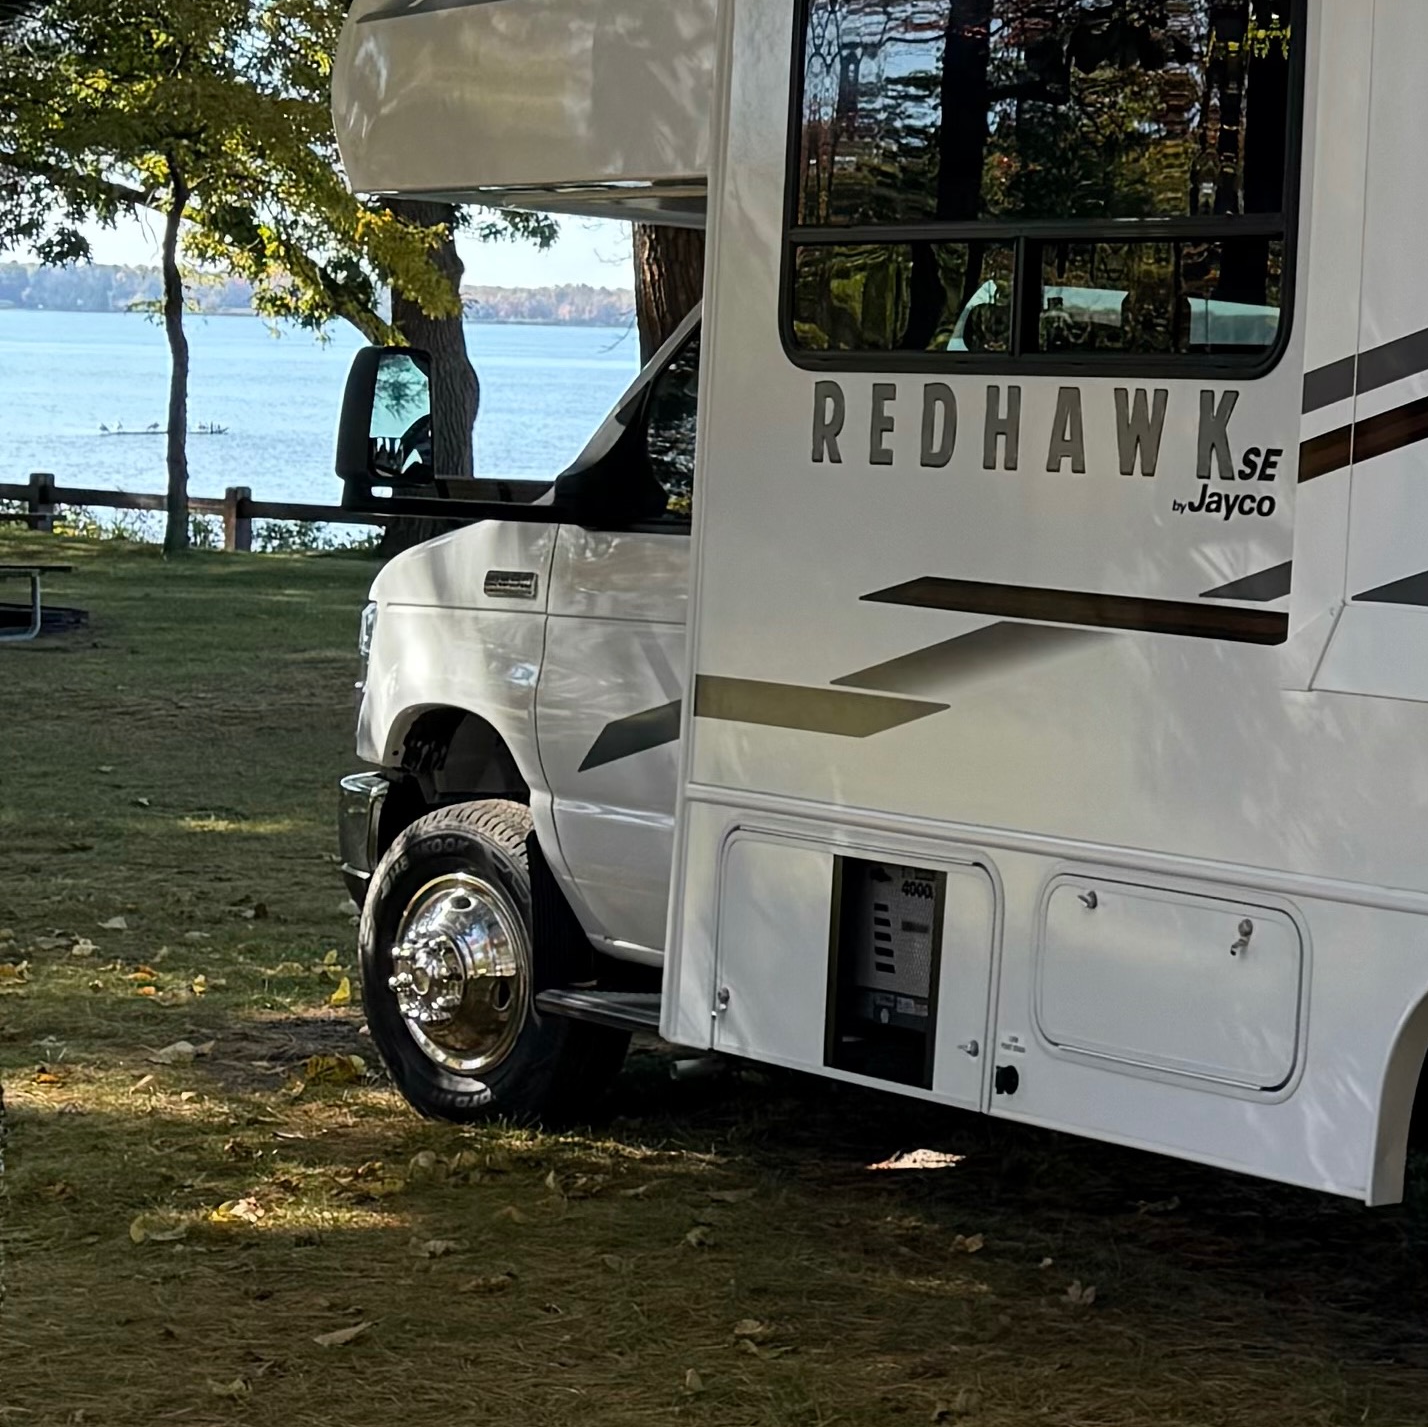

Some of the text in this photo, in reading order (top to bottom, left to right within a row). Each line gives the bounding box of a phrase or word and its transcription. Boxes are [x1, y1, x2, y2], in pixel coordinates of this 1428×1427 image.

[811, 379, 1283, 481] REDHAWK SE
[1172, 483, 1276, 521] by Jayco
